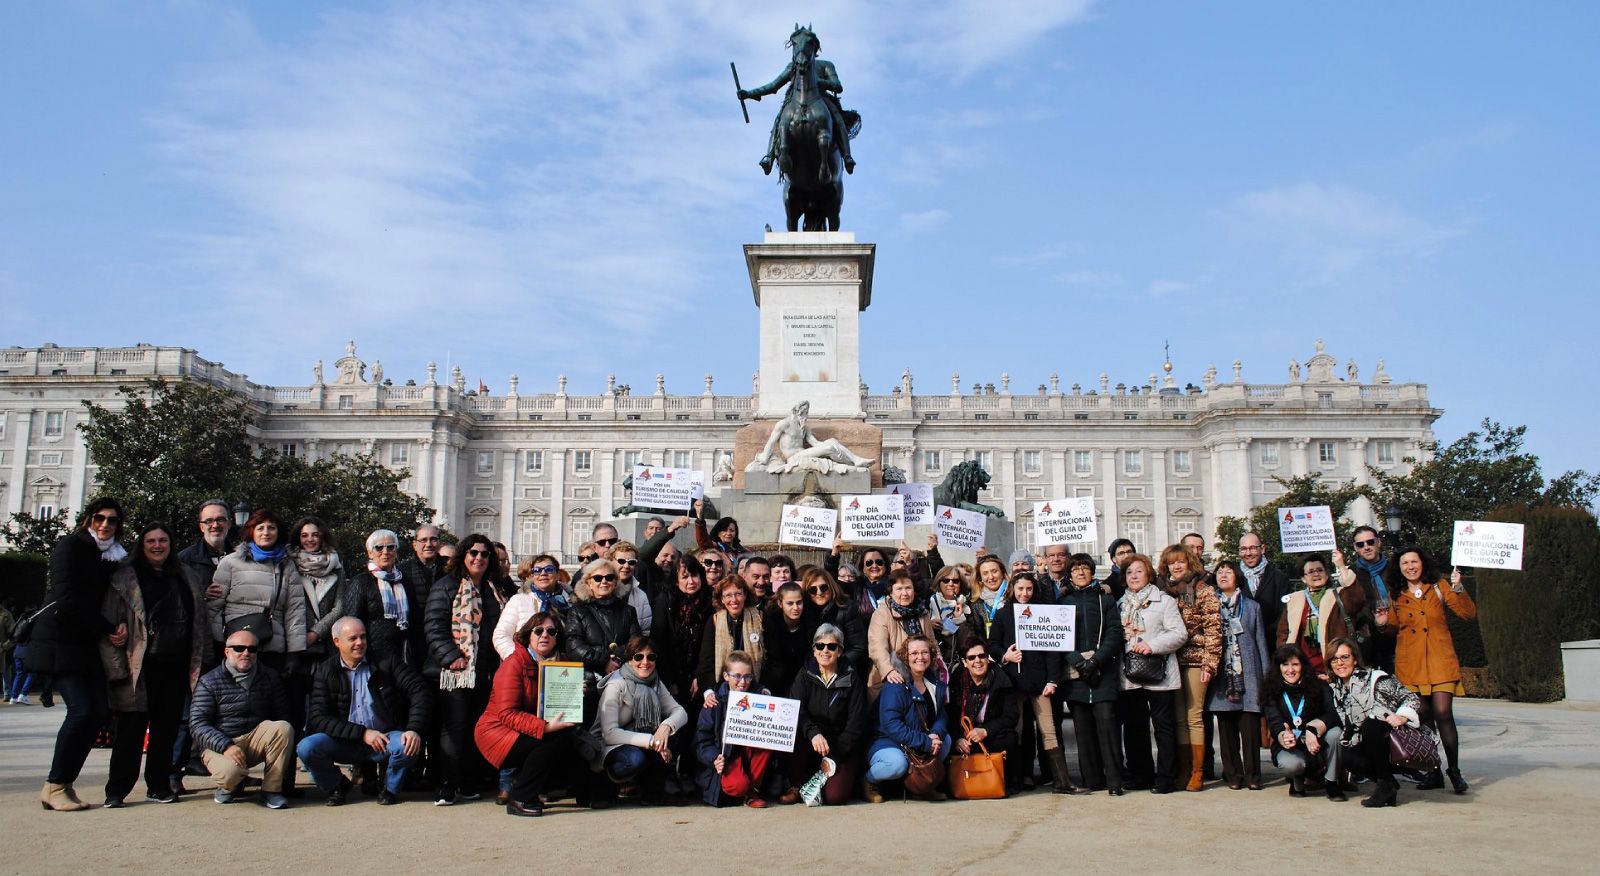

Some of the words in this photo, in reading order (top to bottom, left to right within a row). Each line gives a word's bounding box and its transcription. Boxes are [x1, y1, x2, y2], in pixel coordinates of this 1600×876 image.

[1039, 516, 1093, 527] INTERNACIONAL
[785, 522, 832, 532] INTERNACIONAL
[938, 523, 982, 536] INTERNACIONAL
[946, 539, 972, 548] TURISMO
[1458, 541, 1519, 550] INTERNACIONAL
[729, 718, 757, 726] TURISMO
[767, 723, 793, 732] CALIDAD
[728, 726, 755, 734] ACCESIBLE
[762, 731, 792, 739] SOSTENIBLE
[766, 738, 792, 746] OFICIALES
